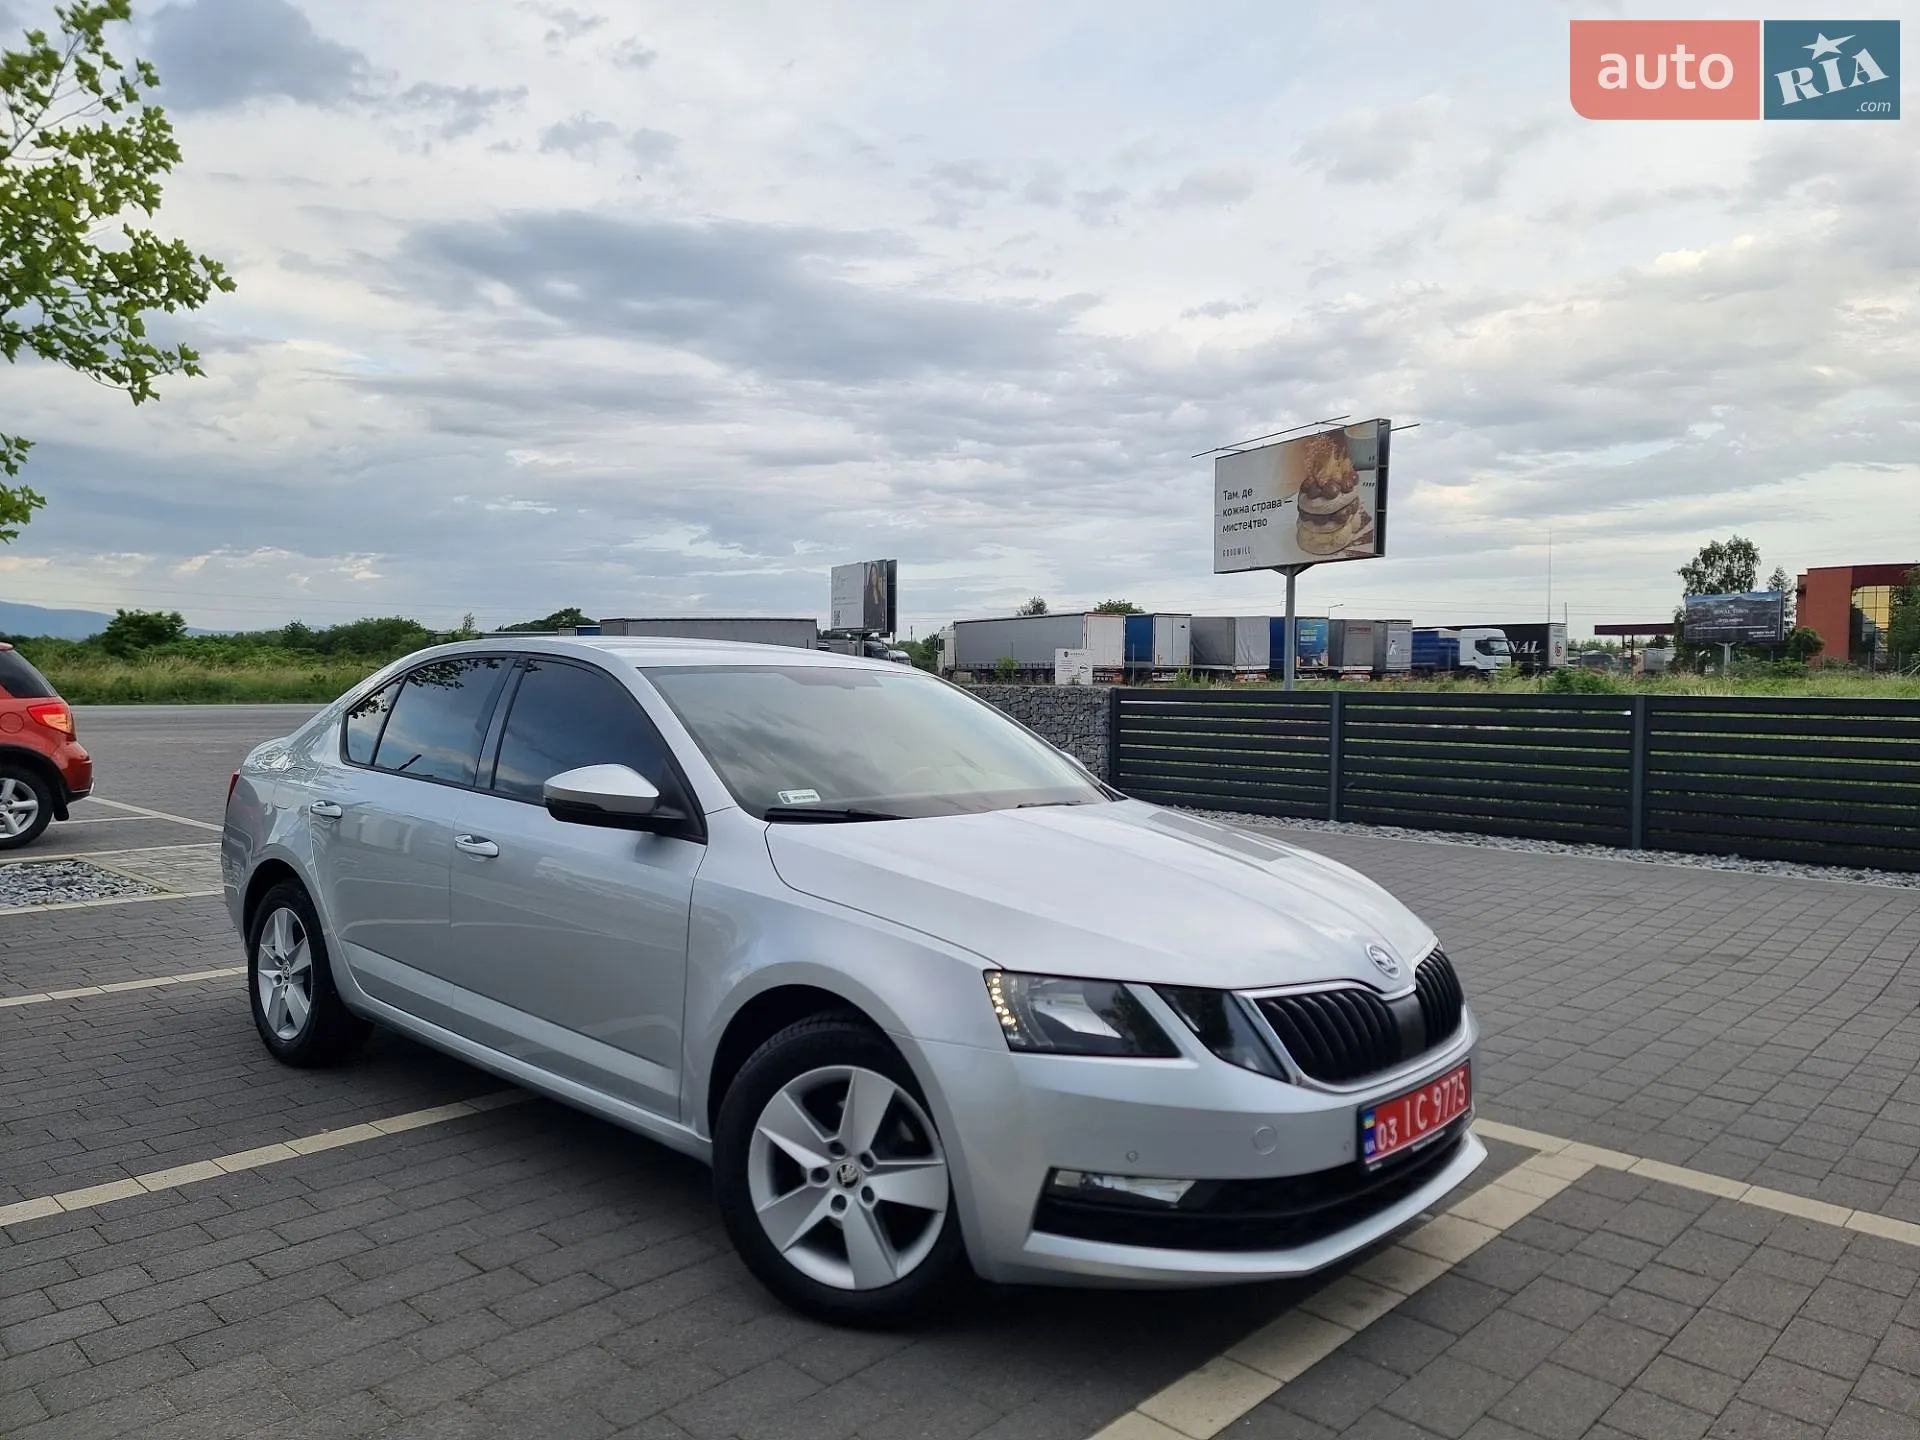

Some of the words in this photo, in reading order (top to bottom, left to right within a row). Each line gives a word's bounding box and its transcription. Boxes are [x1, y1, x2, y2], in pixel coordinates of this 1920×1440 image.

[1241, 487, 1253, 499] де
[1222, 505, 1250, 517] кожна
[1251, 499, 1282, 513] страва
[1376, 1118, 1398, 1151] 03
[1433, 1070, 1466, 1123] 9775
